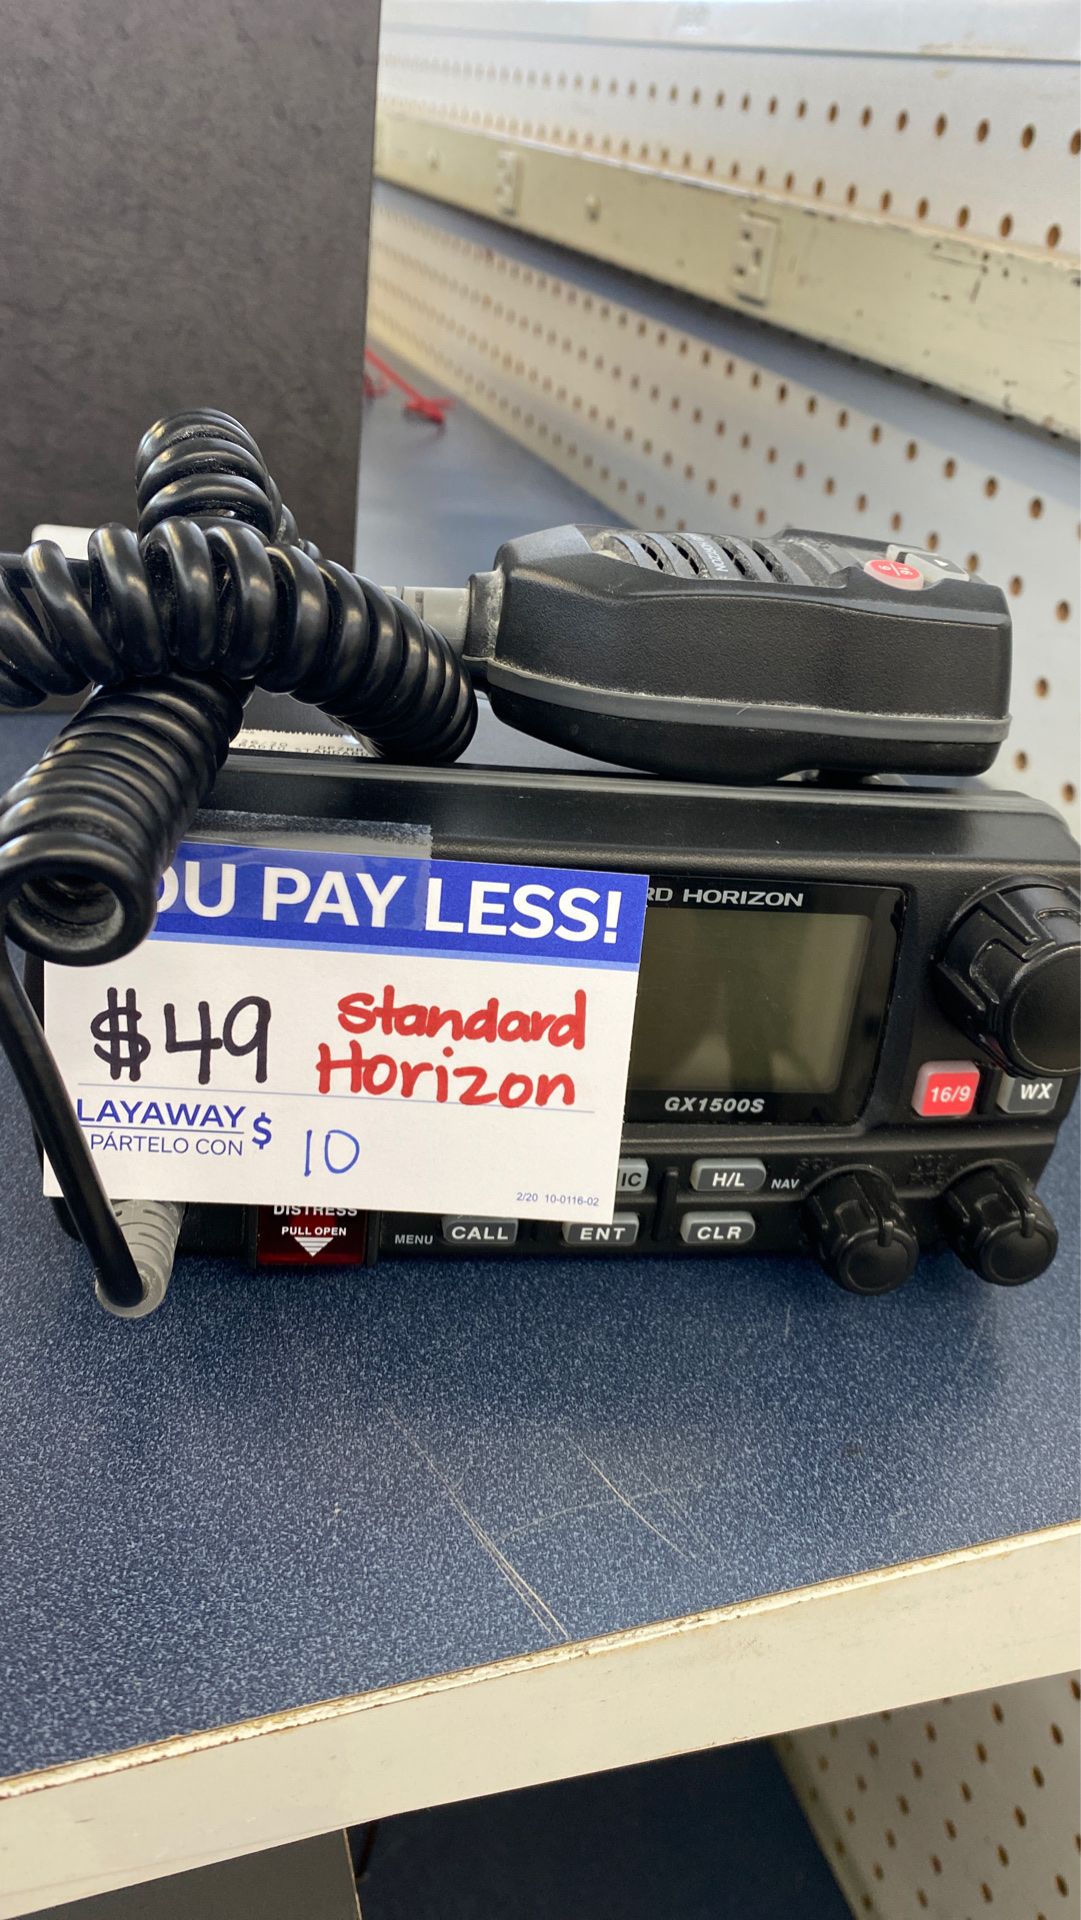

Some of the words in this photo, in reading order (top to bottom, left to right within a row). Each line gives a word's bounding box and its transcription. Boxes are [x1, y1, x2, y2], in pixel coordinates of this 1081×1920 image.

[262, 866, 407, 929] PAY
[424, 877, 622, 944] LESS!
[682, 888, 804, 907] HORIZON
[90, 986, 272, 1085] $49
[315, 1039, 576, 1109] Horizon
[930, 1086, 971, 1103] 16/9
[1020, 1082, 1053, 1100] WX
[664, 1096, 765, 1113] GX1500S
[77, 1098, 246, 1128] LAYAWAY
[251, 1112, 272, 1150] $
[303, 1129, 361, 1178] 10
[90, 1131, 189, 1153] PÁRTELO
[195, 1138, 243, 1156] CON
[712, 1172, 745, 1187] H/L
[770, 1178, 800, 1190] NAV
[516, 1191, 539, 1202] 2/20
[545, 1194, 600, 1207] 10-0116-02
[281, 1226, 312, 1236] PULL
[314, 1226, 347, 1237] OPEN
[394, 1234, 433, 1245] MENU
[451, 1226, 509, 1241] CALL
[579, 1227, 626, 1241] ENT
[697, 1226, 742, 1240] CLR
